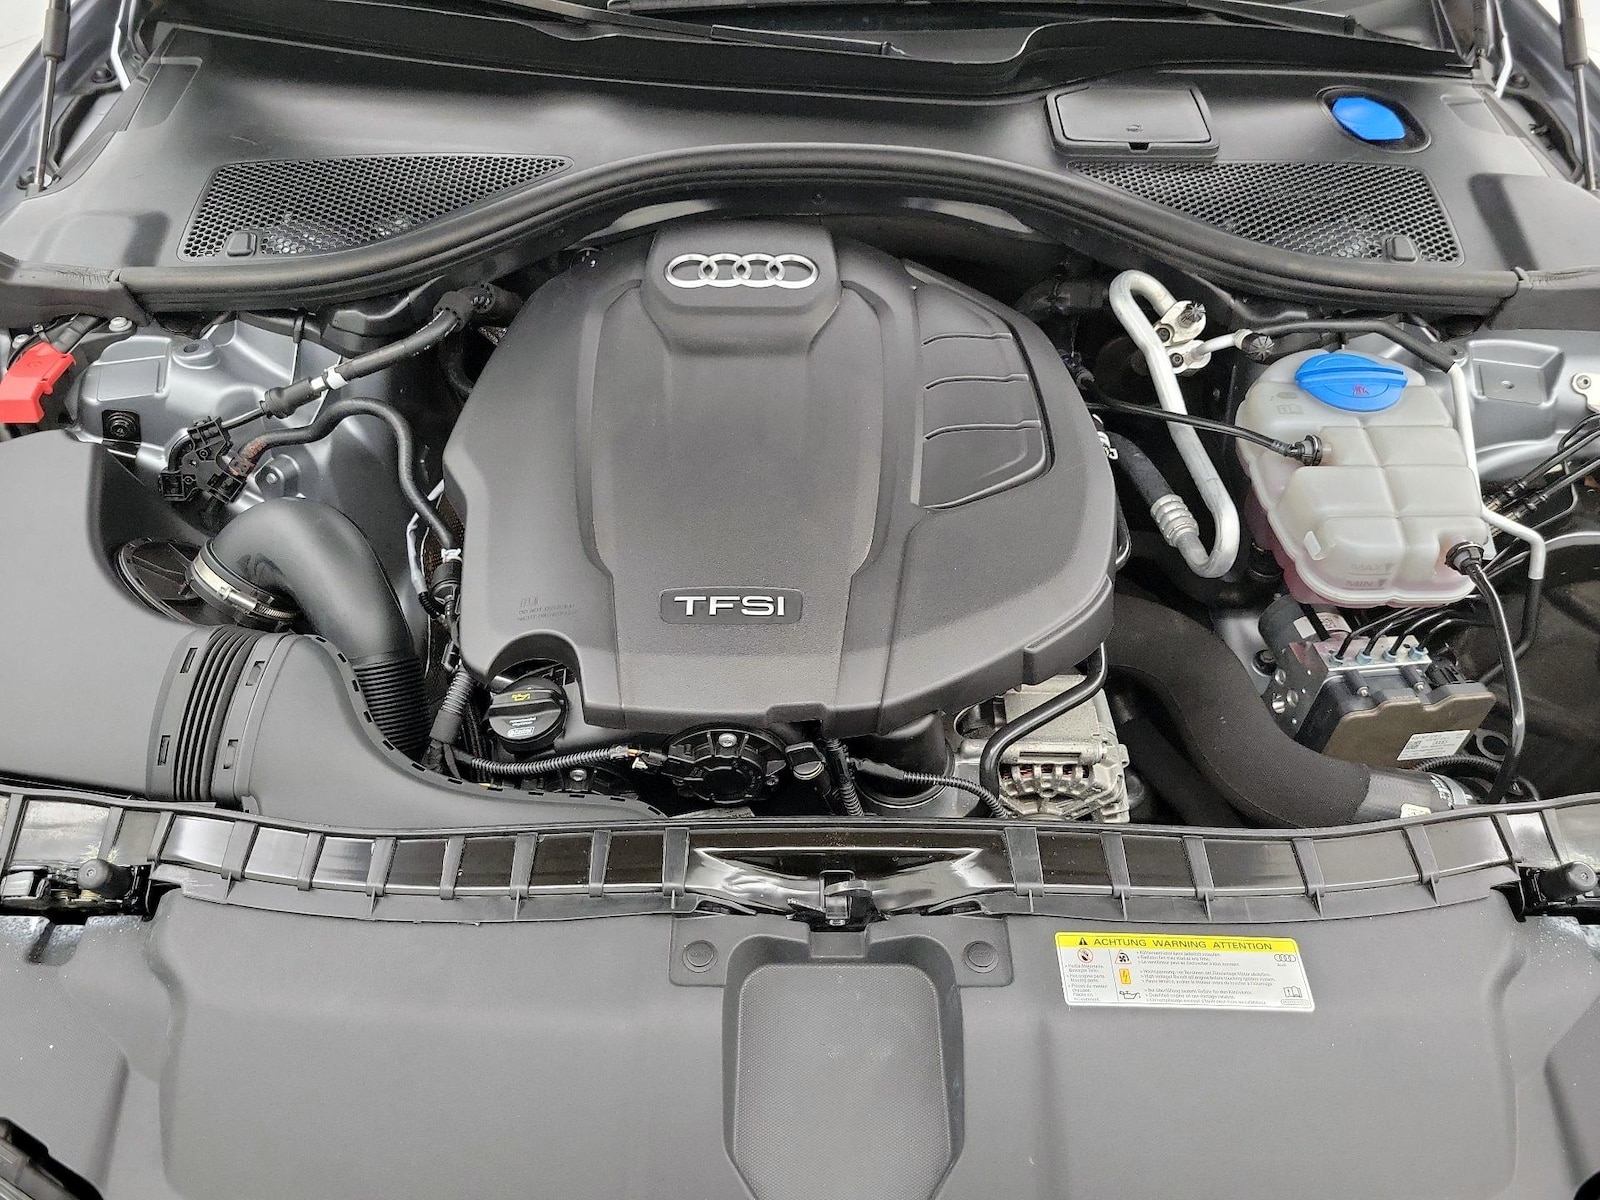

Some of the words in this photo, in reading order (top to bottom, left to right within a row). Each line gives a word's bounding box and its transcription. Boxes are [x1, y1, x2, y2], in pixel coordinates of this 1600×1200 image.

[674, 595, 785, 616] TFSI
[1093, 938, 1147, 947] ACHTUNG
[1152, 939, 1207, 949] WARNING
[1213, 940, 1273, 950] ATTENTION
